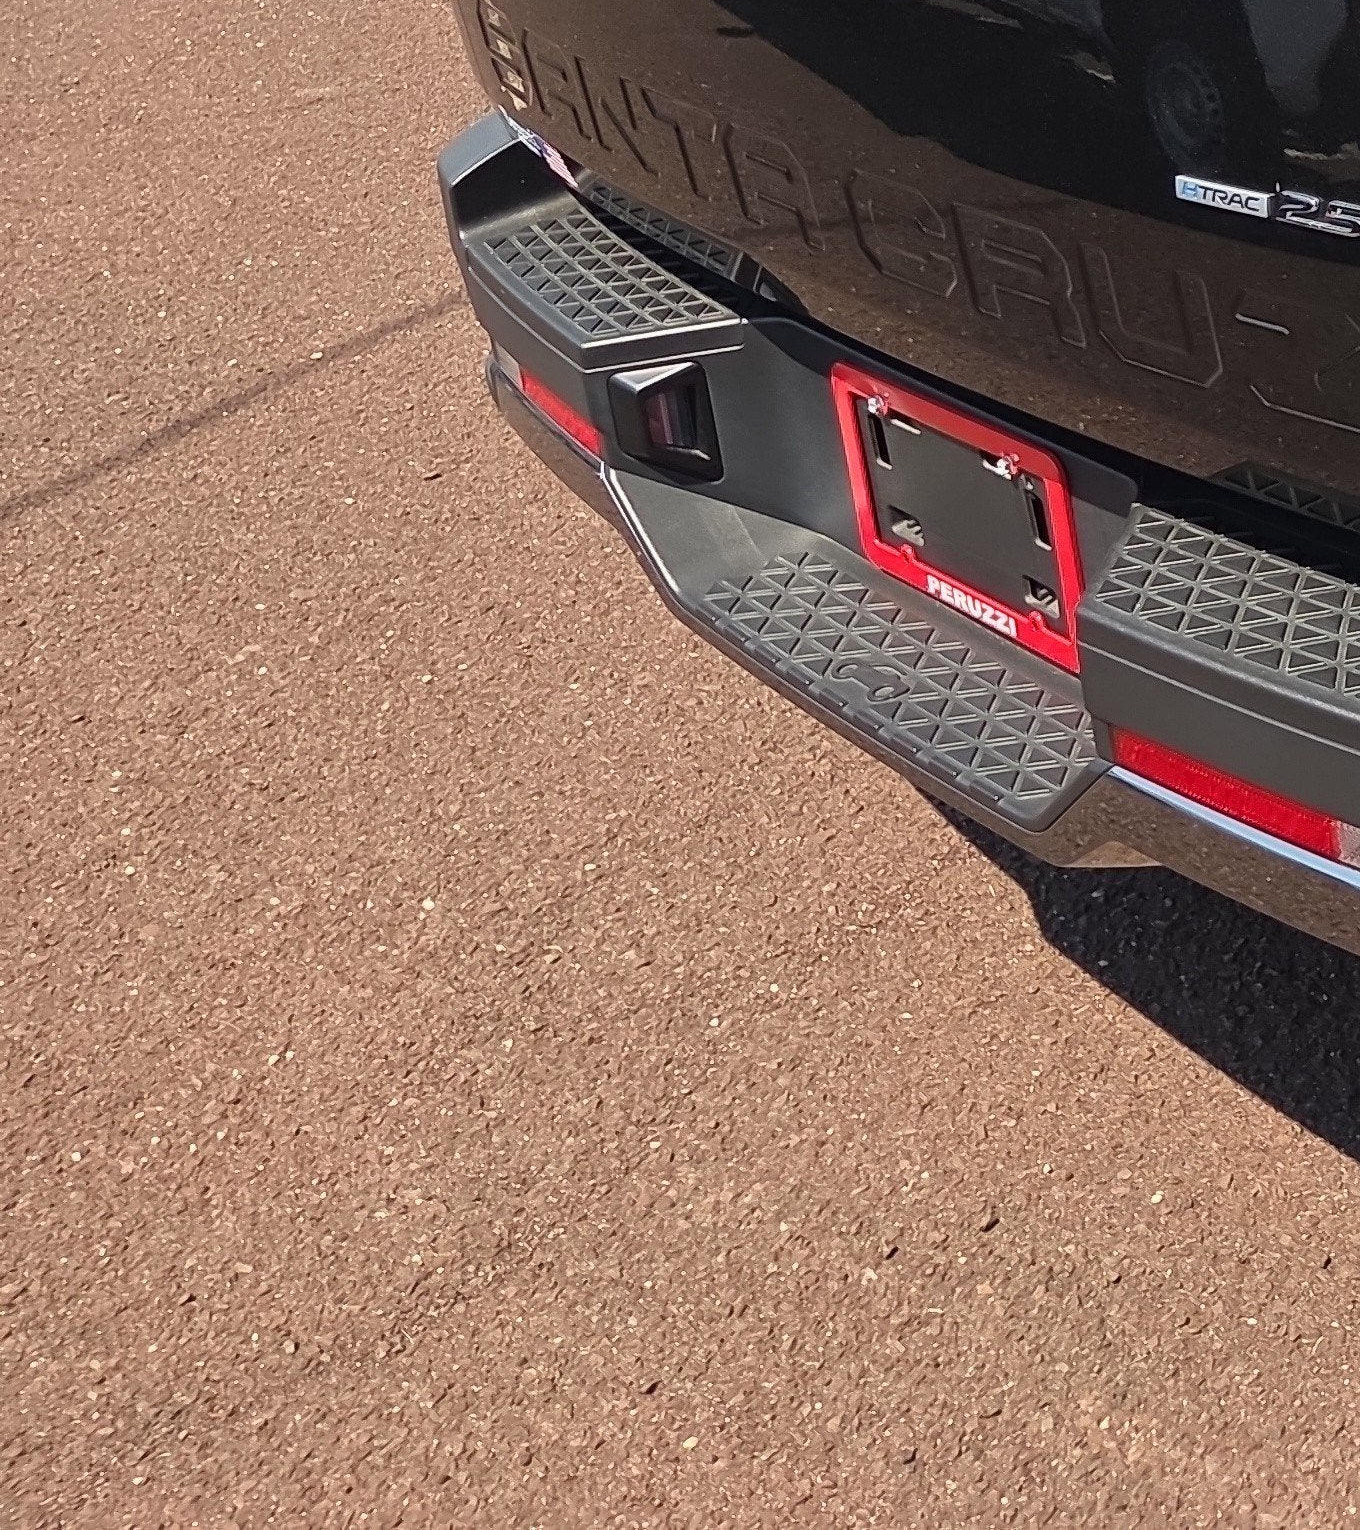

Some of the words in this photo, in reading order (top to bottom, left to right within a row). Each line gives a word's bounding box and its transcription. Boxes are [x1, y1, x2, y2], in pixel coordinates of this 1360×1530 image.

[477, 0, 826, 252] SANTA
[1181, 181, 1261, 213] HTRAC
[926, 573, 1019, 638] PERUZZI
